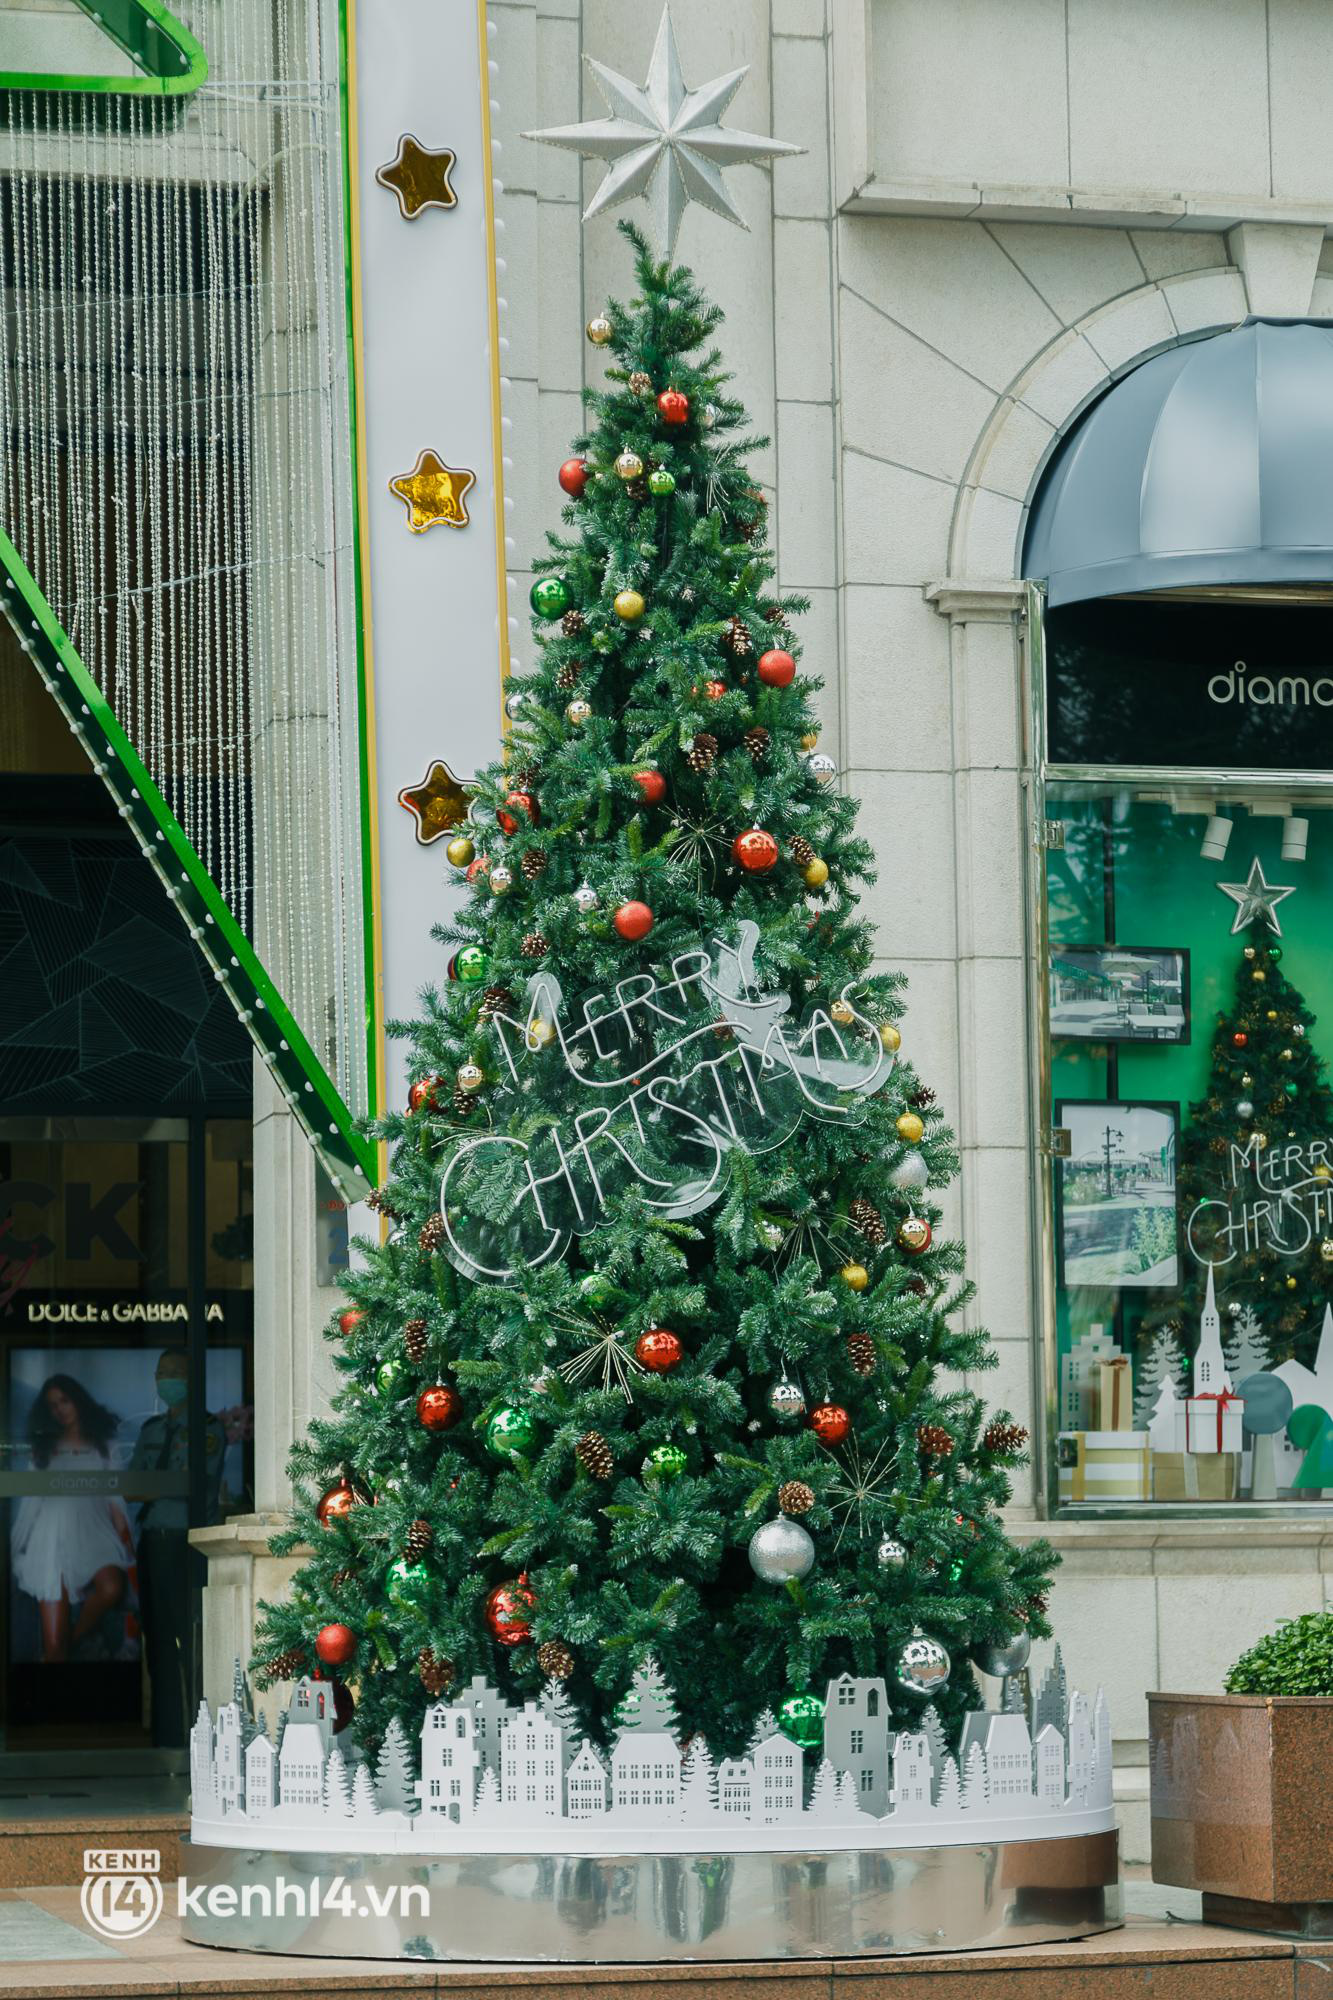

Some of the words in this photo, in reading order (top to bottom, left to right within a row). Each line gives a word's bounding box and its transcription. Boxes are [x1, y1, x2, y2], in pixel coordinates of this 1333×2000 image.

[492, 928, 783, 1087] MERRY
[440, 981, 884, 1277] CHRISTMAS
[28, 1302, 98, 1323] DOLCE
[100, 1308, 110, 1322] &
